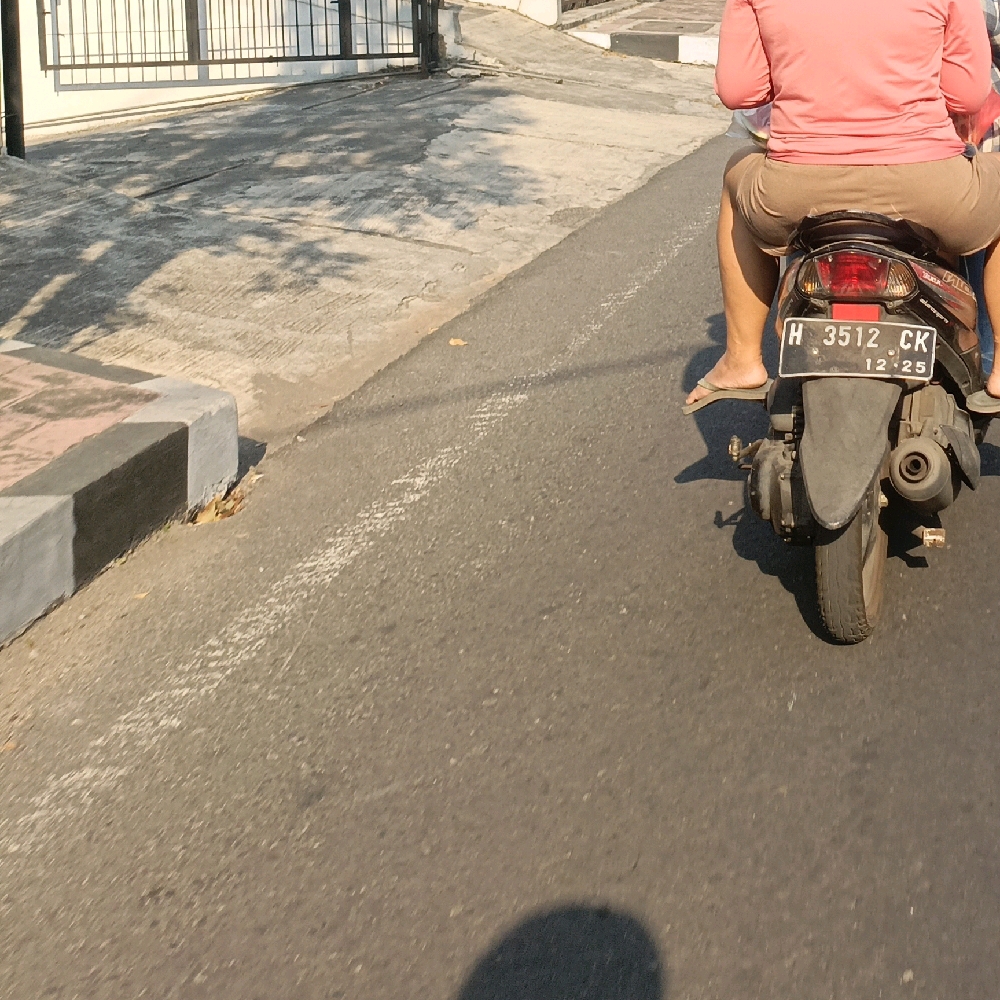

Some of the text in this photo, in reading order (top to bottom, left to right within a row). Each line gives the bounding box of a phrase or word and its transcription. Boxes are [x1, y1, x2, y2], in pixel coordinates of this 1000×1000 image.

[788, 322, 931, 353] H 3512 CK
